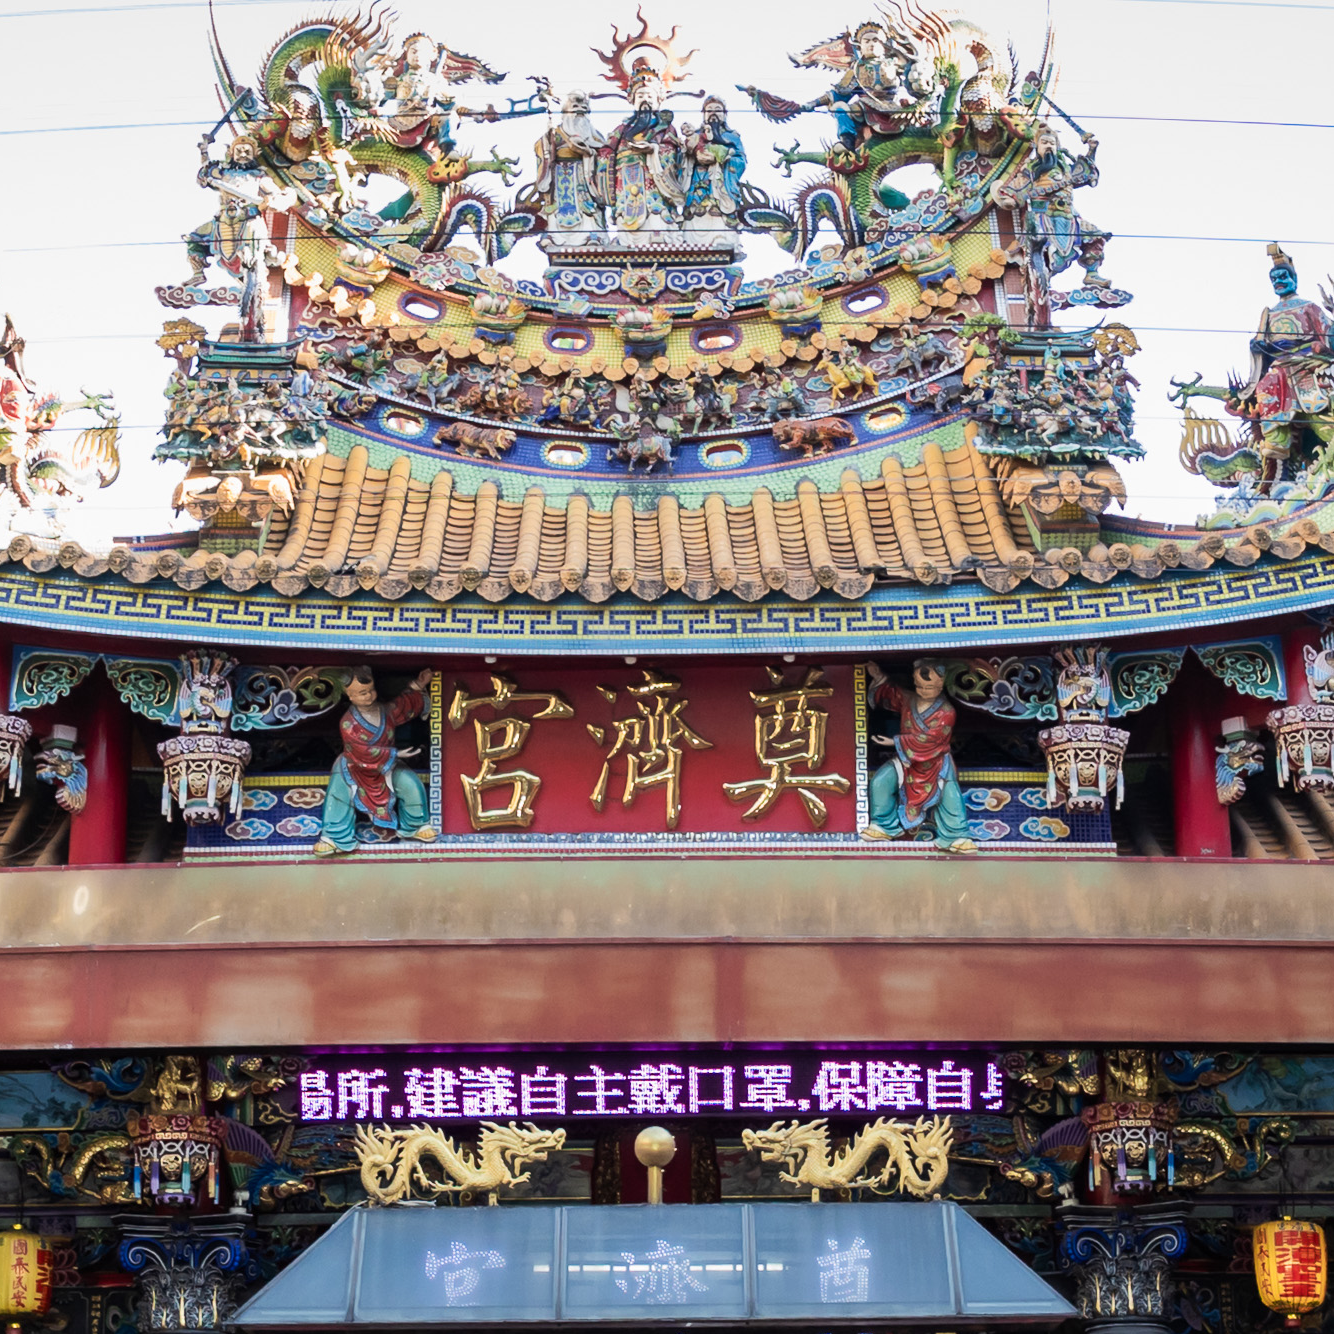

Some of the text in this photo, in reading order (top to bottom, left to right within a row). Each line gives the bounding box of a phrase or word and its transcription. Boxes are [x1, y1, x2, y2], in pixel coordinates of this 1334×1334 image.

[448, 664, 853, 831] 奠濟宮
[10, 1239, 30, 1310] 國泰民安
